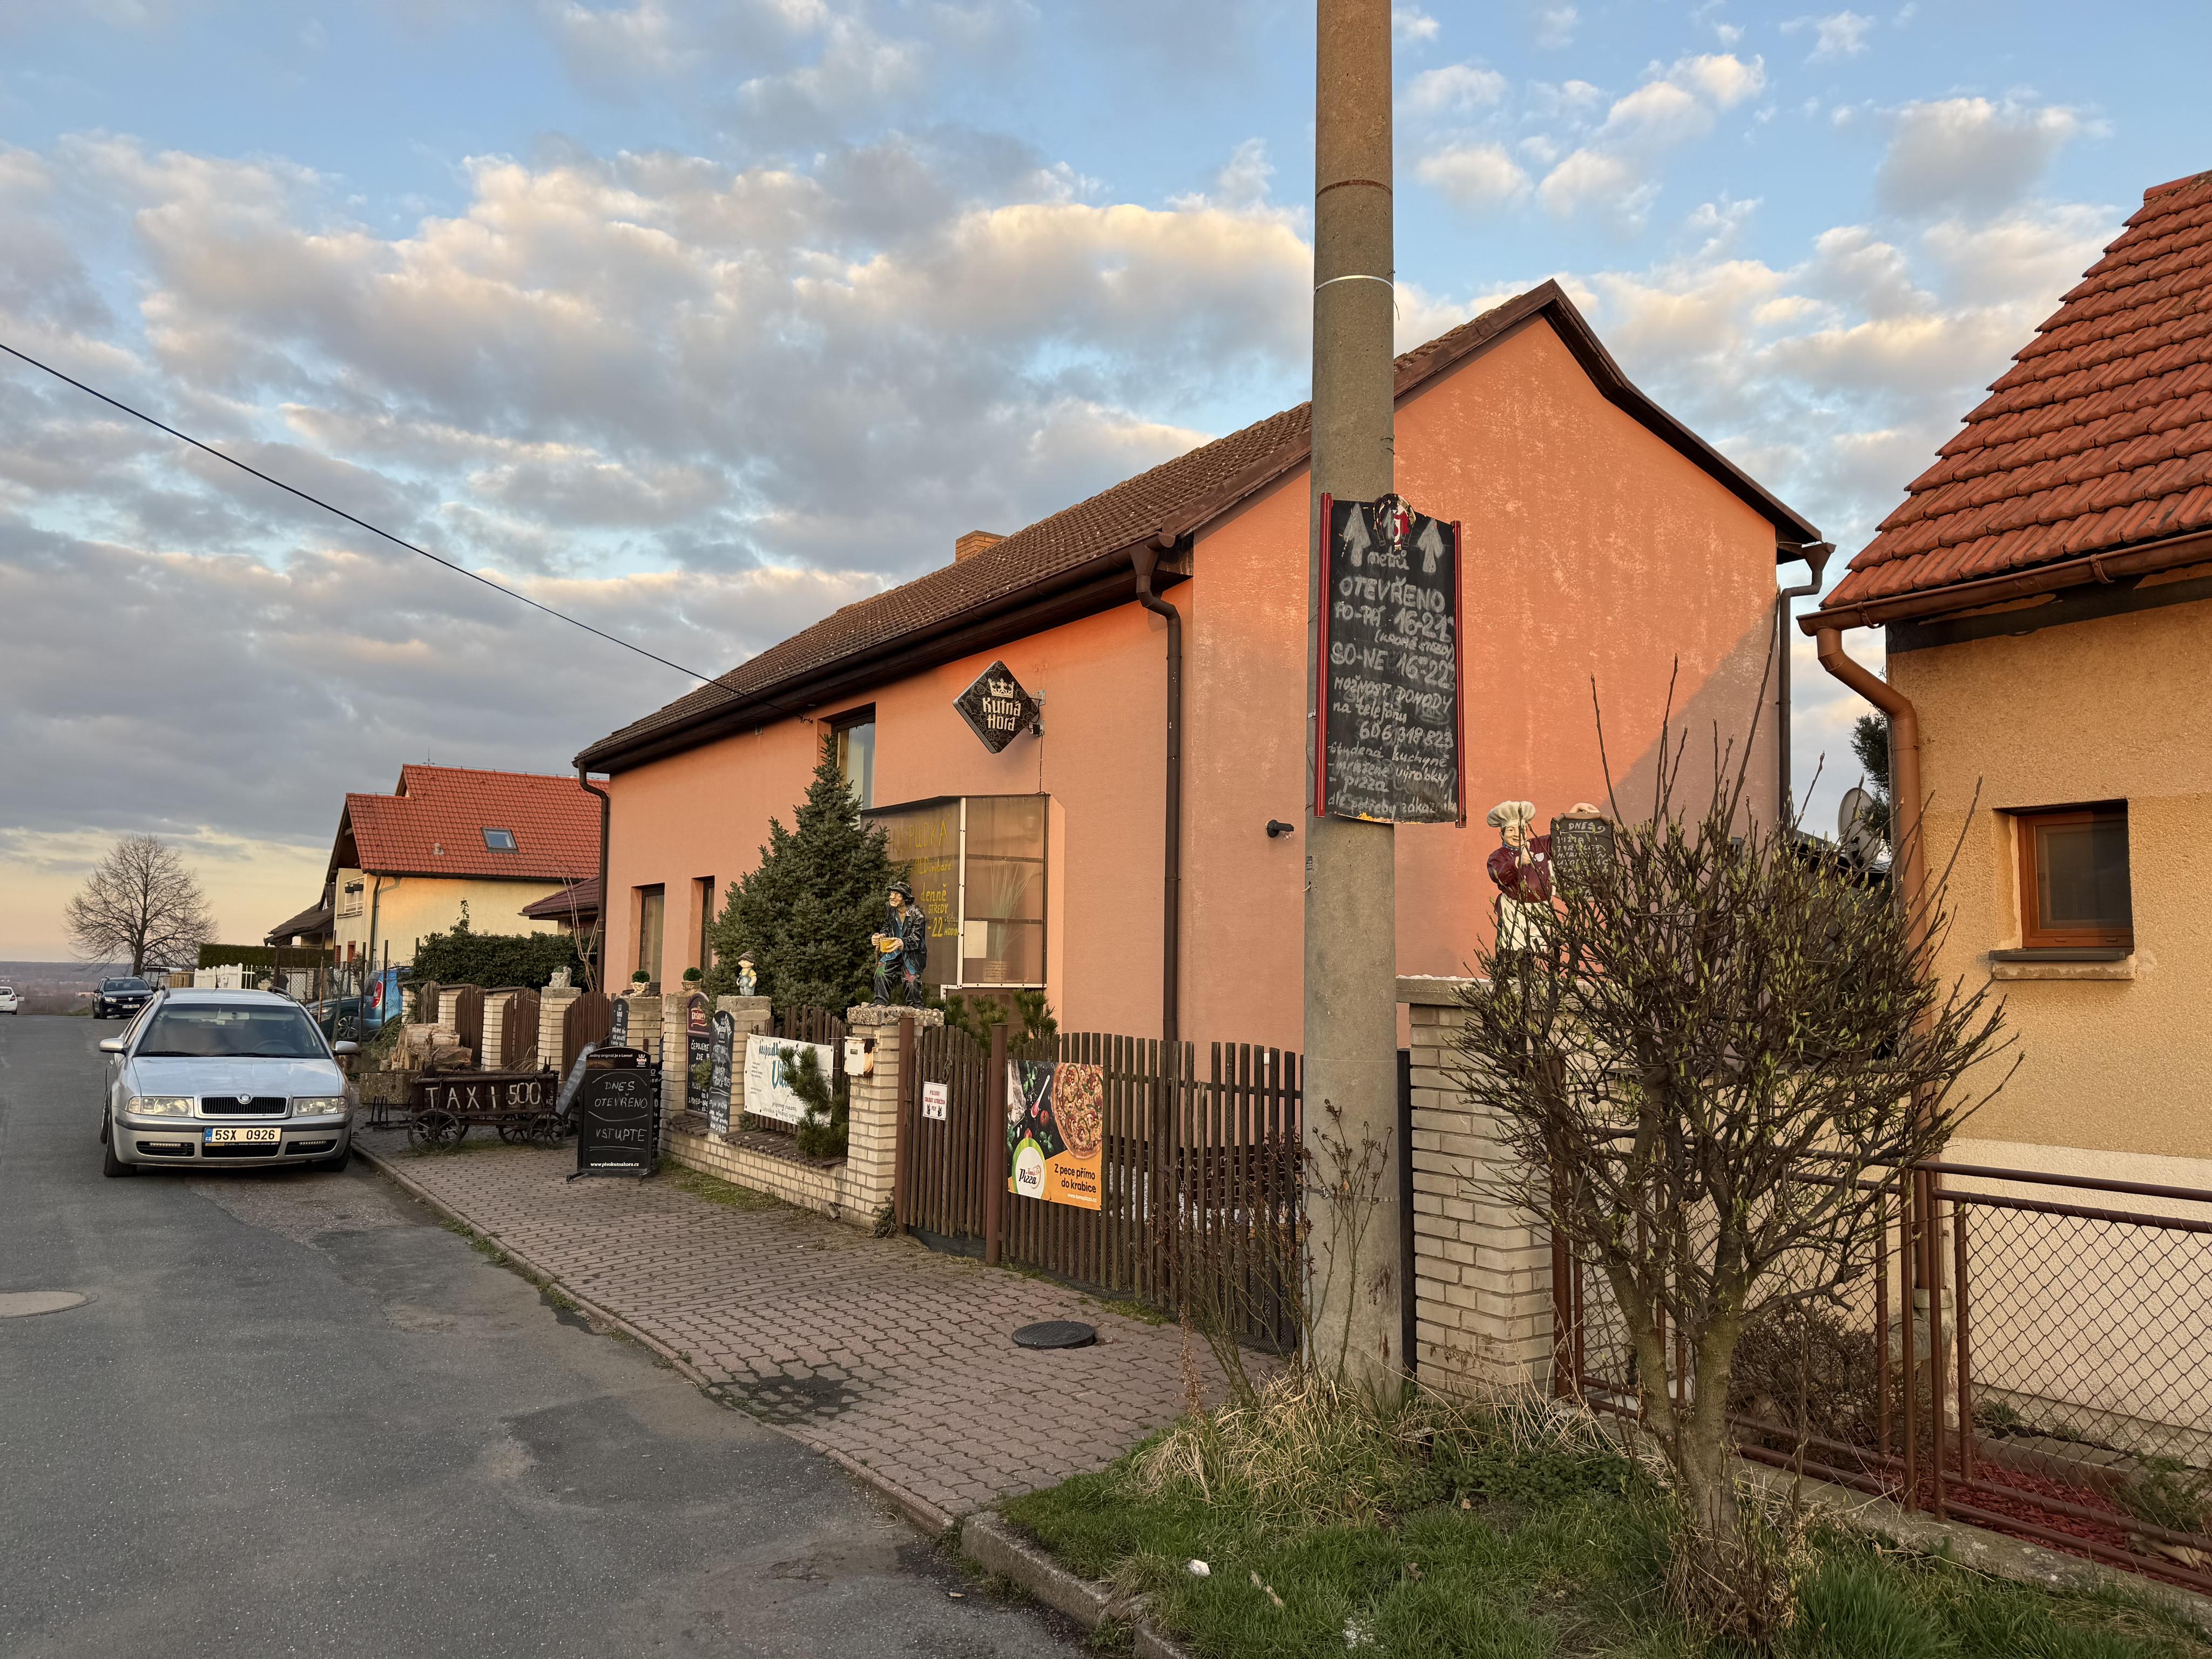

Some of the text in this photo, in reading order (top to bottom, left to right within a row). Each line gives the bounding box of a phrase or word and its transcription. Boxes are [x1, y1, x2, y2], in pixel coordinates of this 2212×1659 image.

[1339, 576, 1445, 613] OTEVŘENO
[1331, 642, 1388, 671] SO-NE
[982, 697, 1021, 717] Kutná
[1333, 702, 1351, 713] na
[987, 713, 1015, 731] Hora
[1359, 720, 1392, 740] 606
[1568, 822, 1594, 830] DNES
[920, 882, 947, 902] denně
[928, 902, 948, 914] STŘEDY
[604, 1081, 635, 1091] DNES
[425, 1085, 496, 1109] TAXI
[508, 1082, 541, 1105] 500
[595, 1092, 648, 1108] OTEVŘENO
[215, 1130, 237, 1141] 5SX
[246, 1130, 275, 1140] 0926
[596, 1129, 648, 1141] VSTUPTE
[1019, 1168, 1037, 1184] Pizza
[1055, 1164, 1095, 1179] Z pece přímo
[1061, 1177, 1096, 1193] do krabice
